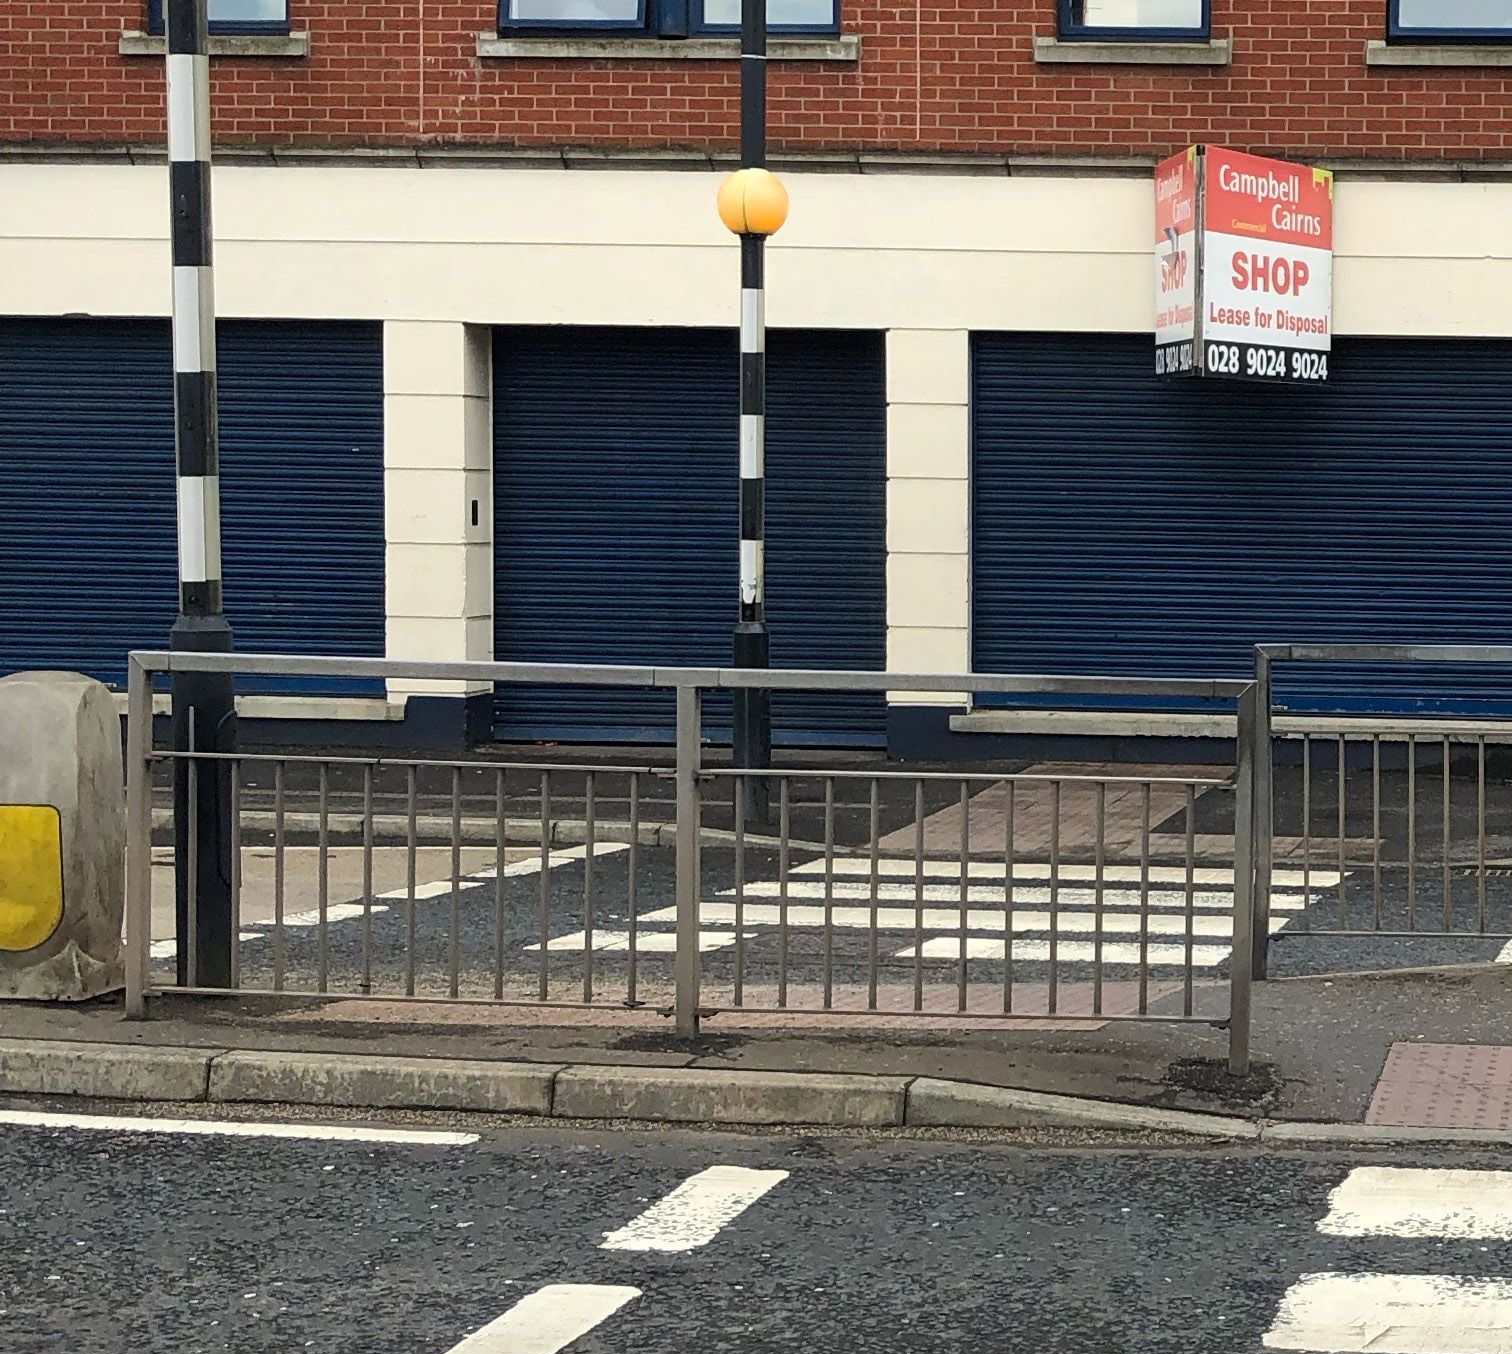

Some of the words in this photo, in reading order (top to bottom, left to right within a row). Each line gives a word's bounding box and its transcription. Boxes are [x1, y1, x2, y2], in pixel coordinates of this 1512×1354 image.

[1219, 164, 1300, 204] Campbell
[1271, 203, 1321, 236] Cairns
[1231, 250, 1310, 297] SHOP
[1209, 301, 1251, 327] Lease
[1254, 306, 1273, 329] for
[1276, 309, 1328, 337] Disposal
[1207, 343, 1240, 374] 028
[1246, 347, 1287, 377] 9024
[1292, 351, 1328, 380] 9024
